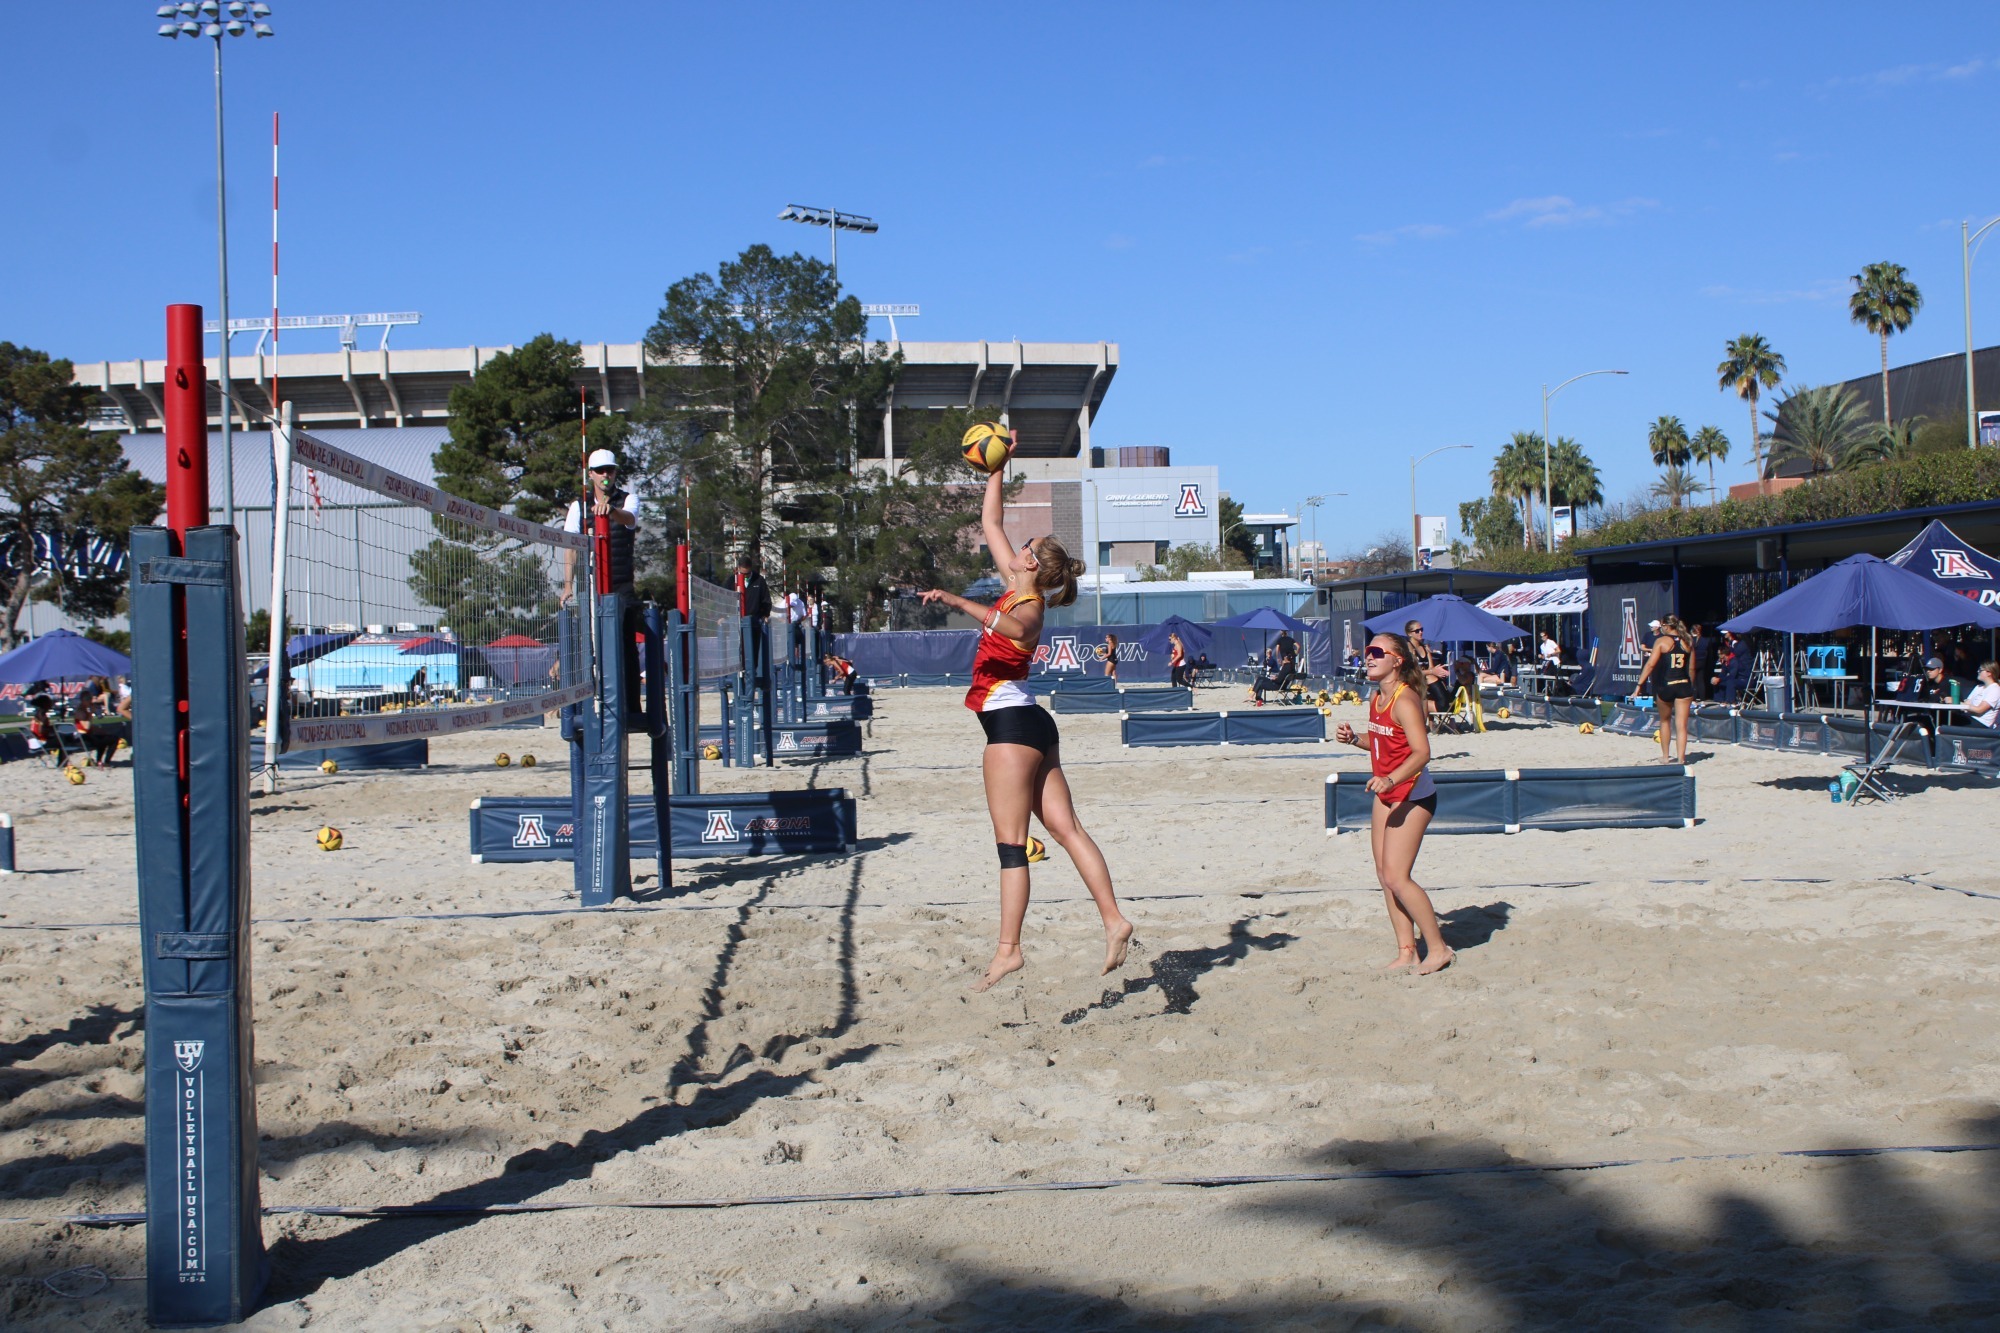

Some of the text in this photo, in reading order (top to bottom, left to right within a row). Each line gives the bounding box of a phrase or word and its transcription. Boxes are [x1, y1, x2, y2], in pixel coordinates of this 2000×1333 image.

[1174, 483, 1207, 517] A
[1931, 549, 1993, 579] A
[1619, 598, 1642, 668] A
[1046, 636, 1086, 673] A
[1671, 653, 1685, 668] 13
[512, 814, 550, 848] A
[701, 810, 811, 843] A ARIZONA
